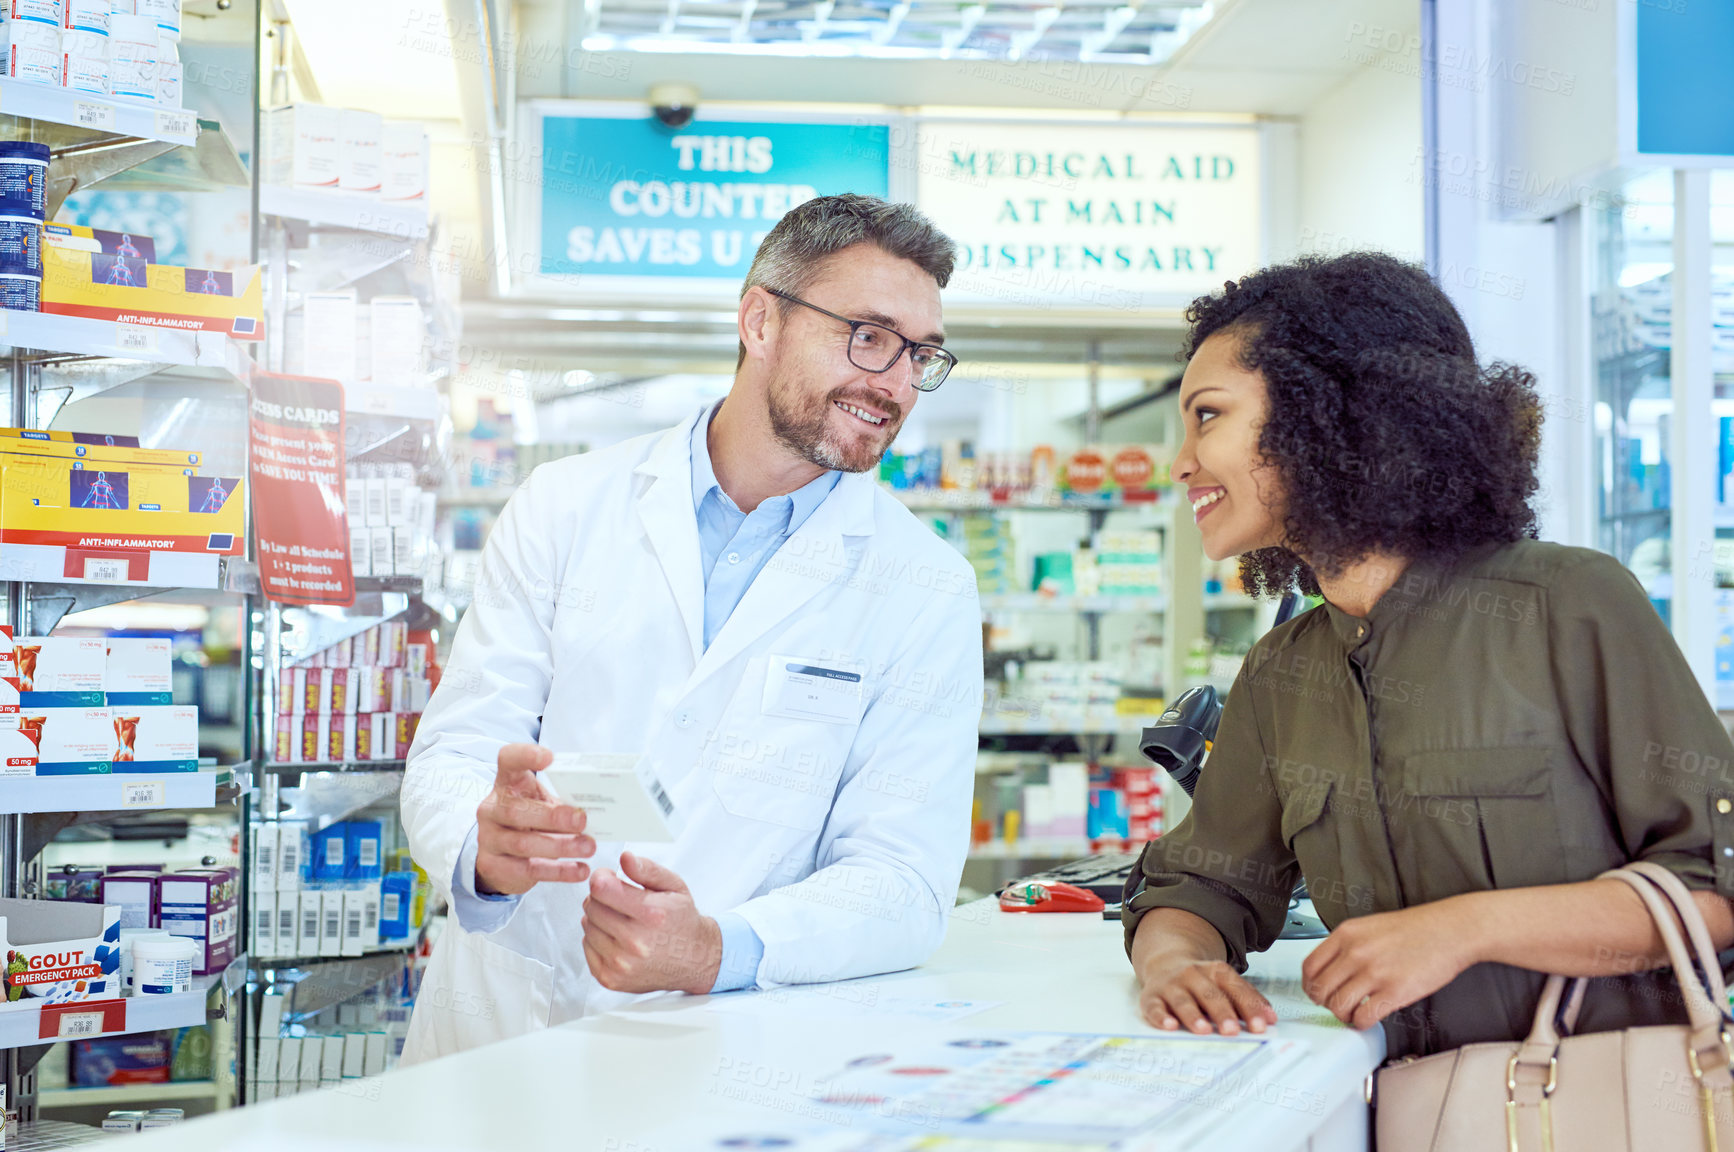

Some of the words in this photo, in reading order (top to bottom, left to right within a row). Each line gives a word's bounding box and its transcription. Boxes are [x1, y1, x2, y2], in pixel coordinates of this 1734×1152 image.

[671, 135, 773, 173] THIS
[951, 151, 1145, 180] MEDICAL
[1161, 155, 1236, 181] AID
[997, 200, 1048, 224] AT
[1066, 201, 1177, 225] MAIN
[567, 226, 701, 266] SAVES
[710, 230, 743, 267] U
[117, 314, 204, 330] ANTI-INFLAMMATORY
[284, 406, 339, 425] CARDS
[271, 436, 305, 450] present
[308, 441, 336, 452] your
[309, 456, 336, 468] Card
[261, 463, 282, 478] SAVE
[283, 468, 306, 481] YOU
[308, 471, 338, 484] TIME
[79, 537, 175, 549] ANTI-INFLAMMATORY
[271, 541, 287, 553] Law
[289, 545, 300, 556] all
[301, 546, 344, 560] Schedule
[291, 562, 332, 575] products
[289, 577, 299, 588] be
[301, 580, 342, 592] recorded
[29, 950, 84, 970] GOUT
[15, 969, 71, 984] EMERGENCY
[72, 966, 95, 978] PACK
